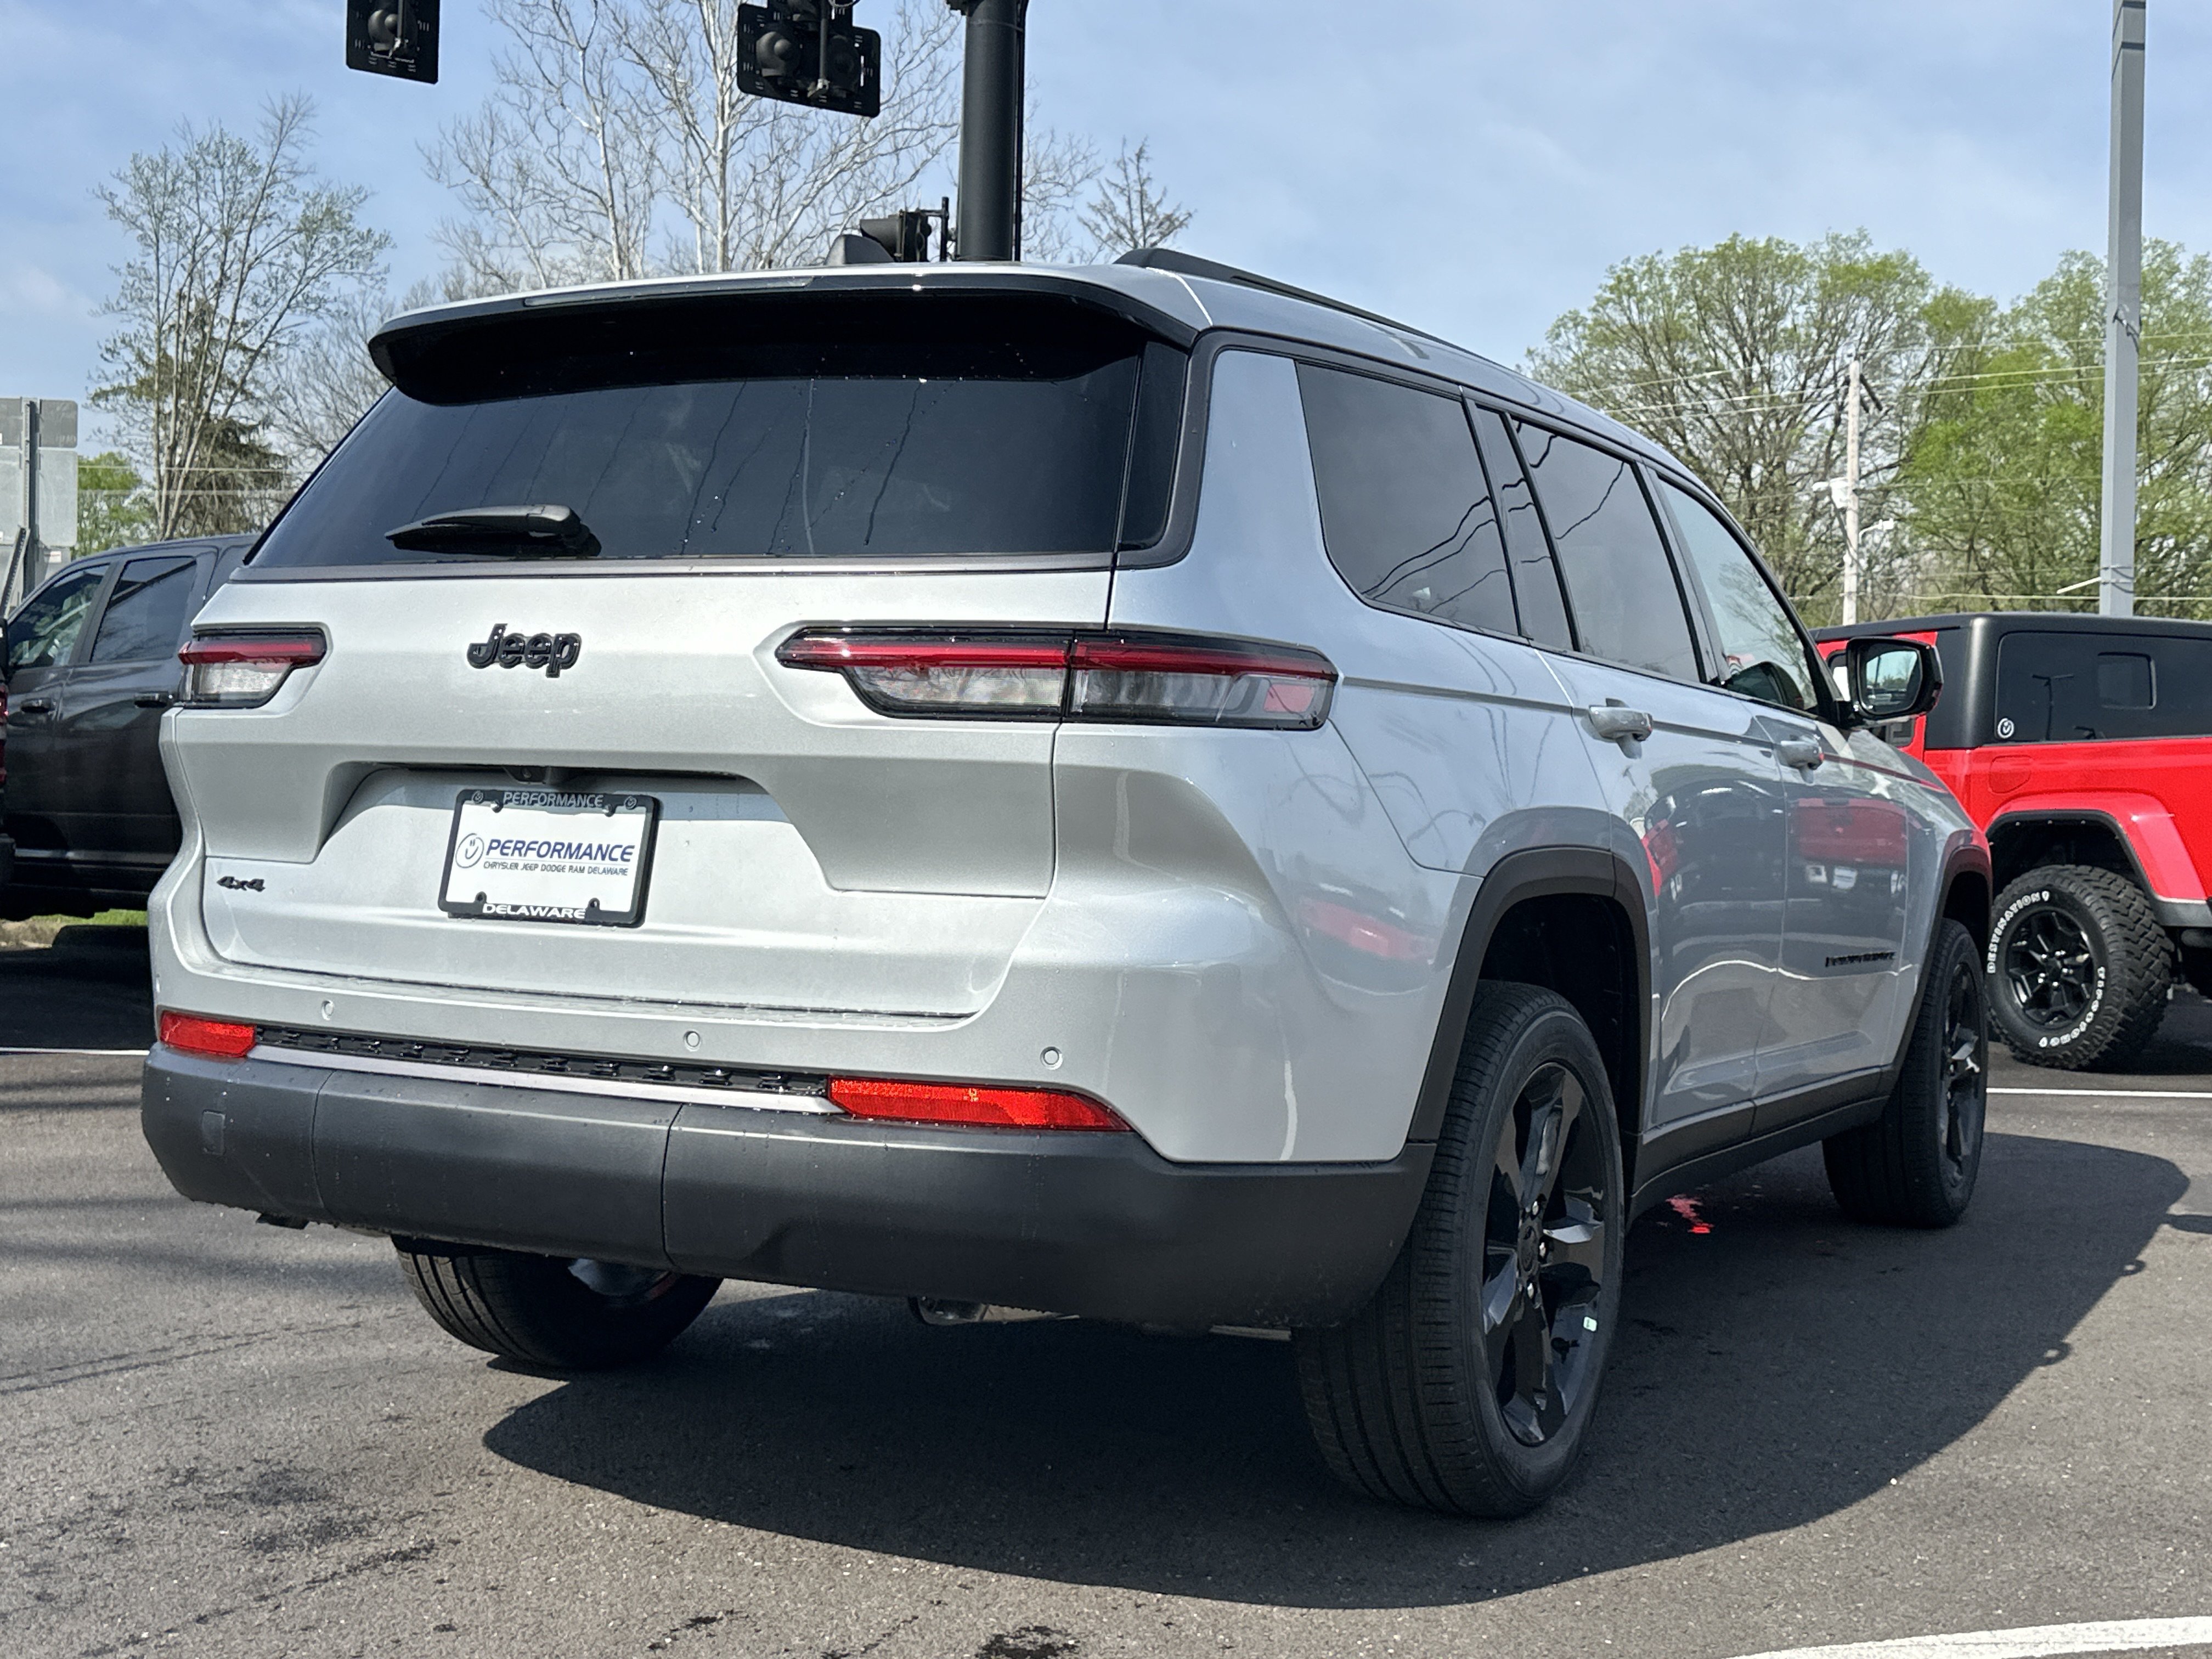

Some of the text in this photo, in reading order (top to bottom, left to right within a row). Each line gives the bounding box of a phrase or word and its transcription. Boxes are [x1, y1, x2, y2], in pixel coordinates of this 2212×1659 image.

[466, 623, 582, 678] Jeep
[503, 792, 605, 808] PERFORMANCE
[486, 839, 635, 862] PERFORMANCE
[483, 860, 629, 876] CHRYSLER JEEP DODGE RAM DELAWARE
[483, 902, 586, 919] DELAWARE
[1987, 891, 2041, 974] DESTINATION
